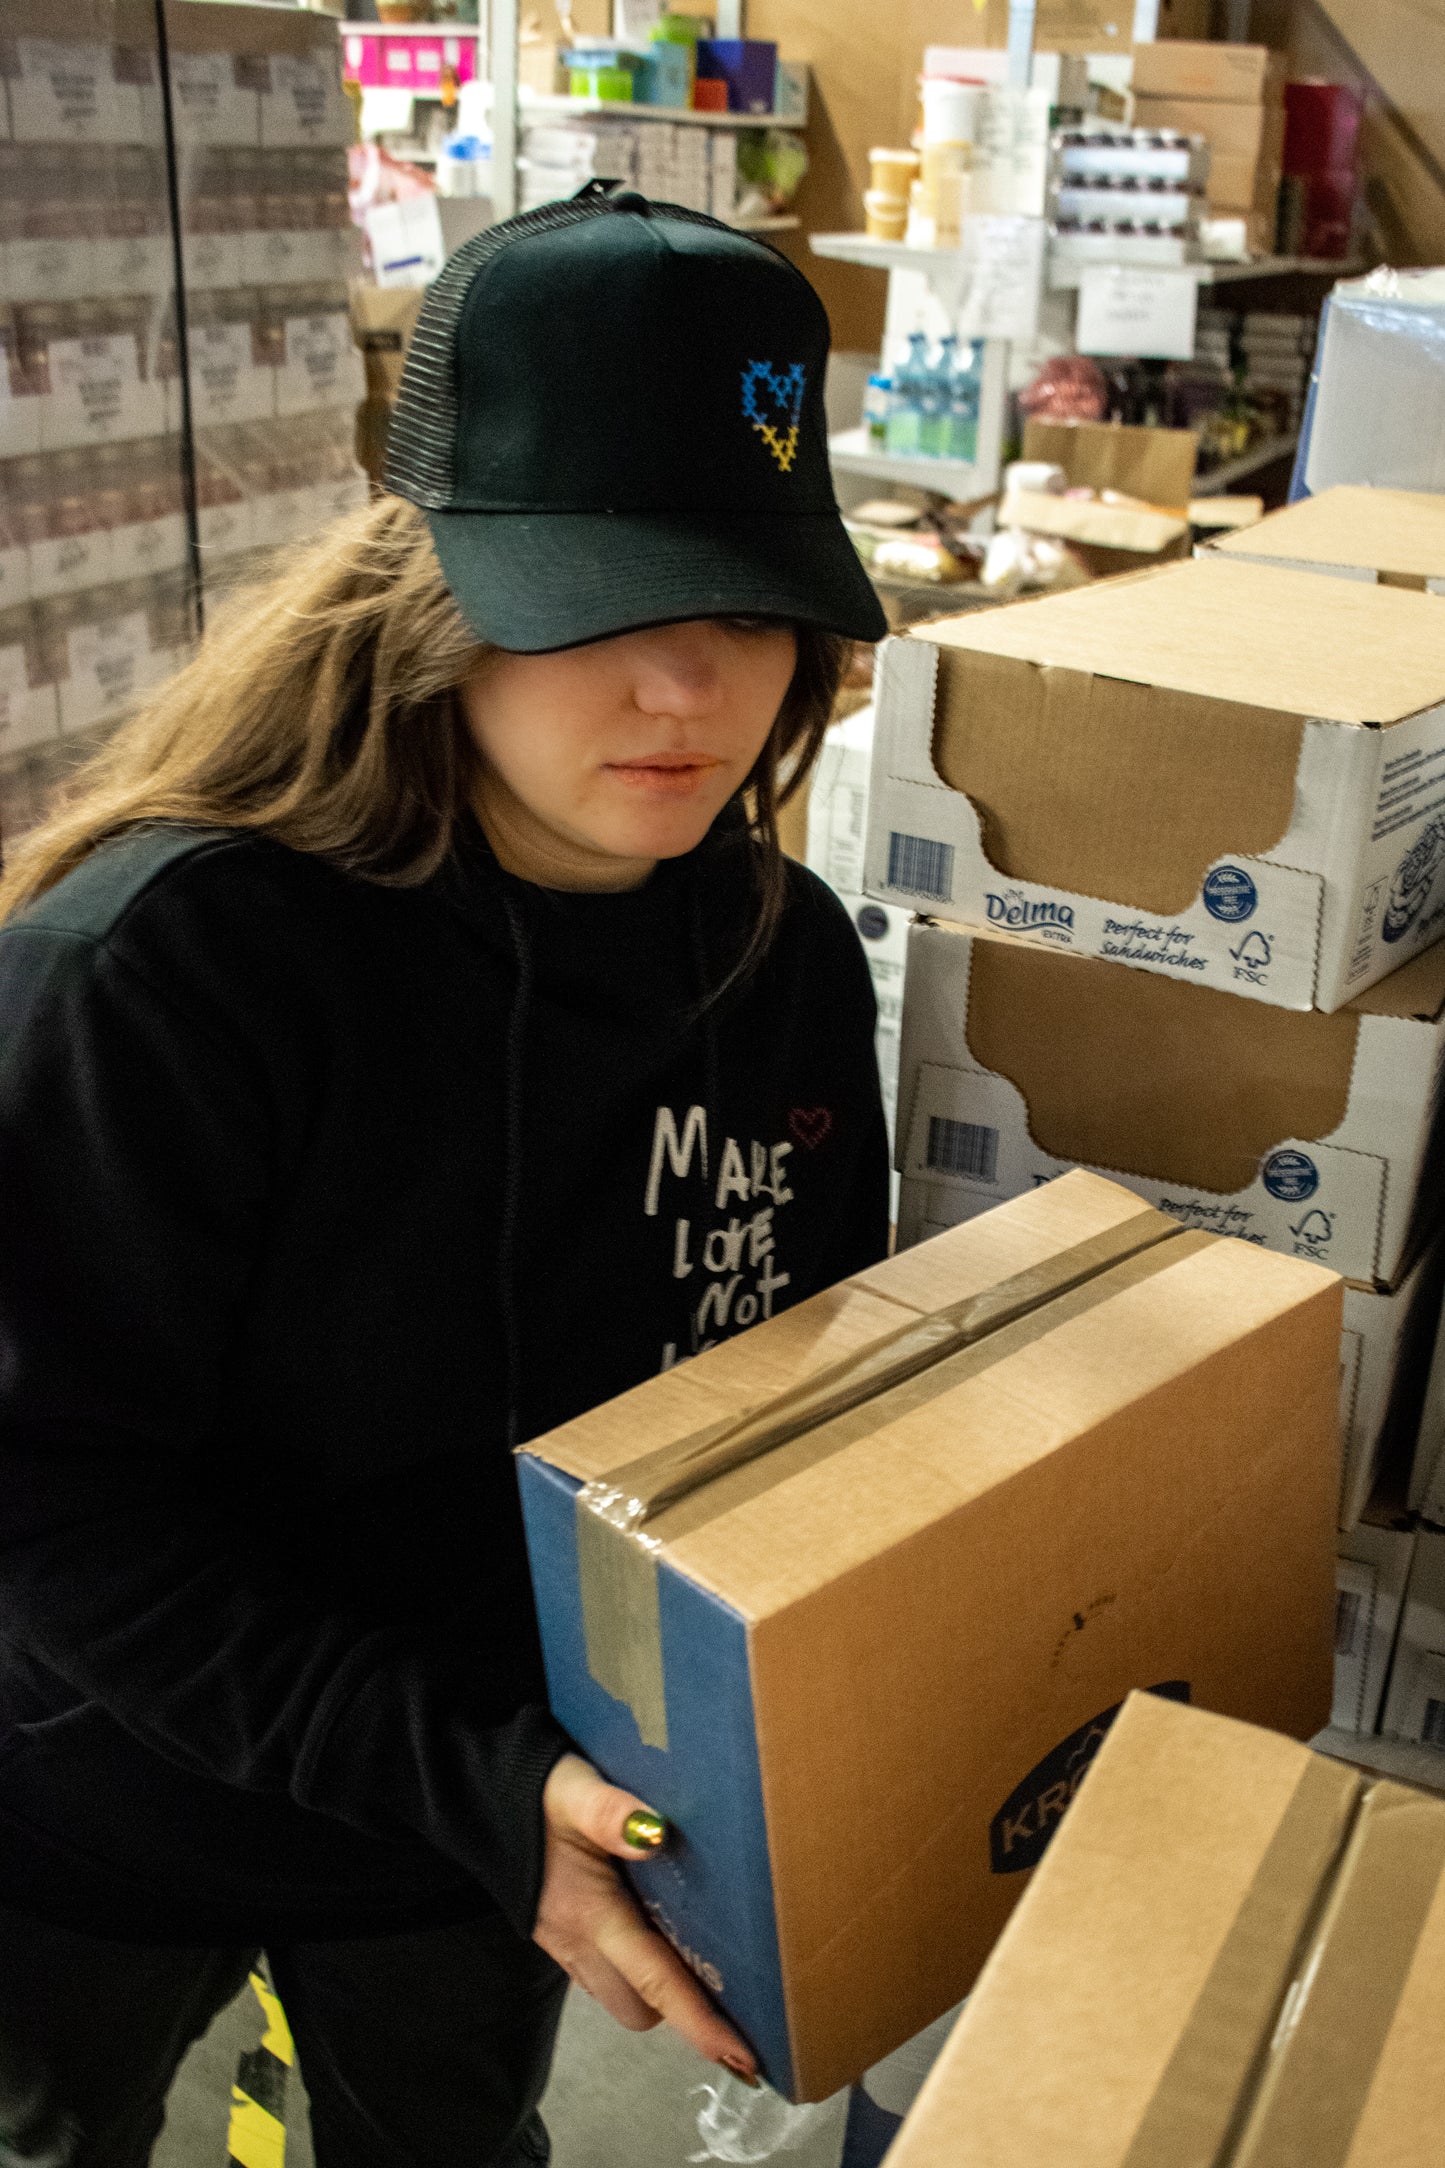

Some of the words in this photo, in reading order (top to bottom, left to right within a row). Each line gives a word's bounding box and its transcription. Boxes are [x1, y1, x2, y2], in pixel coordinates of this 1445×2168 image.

[985, 893, 1075, 928] Delma
[1163, 926, 1196, 951] for
[1233, 965, 1268, 987] FSC
[1294, 1242, 1329, 1261] FSC
